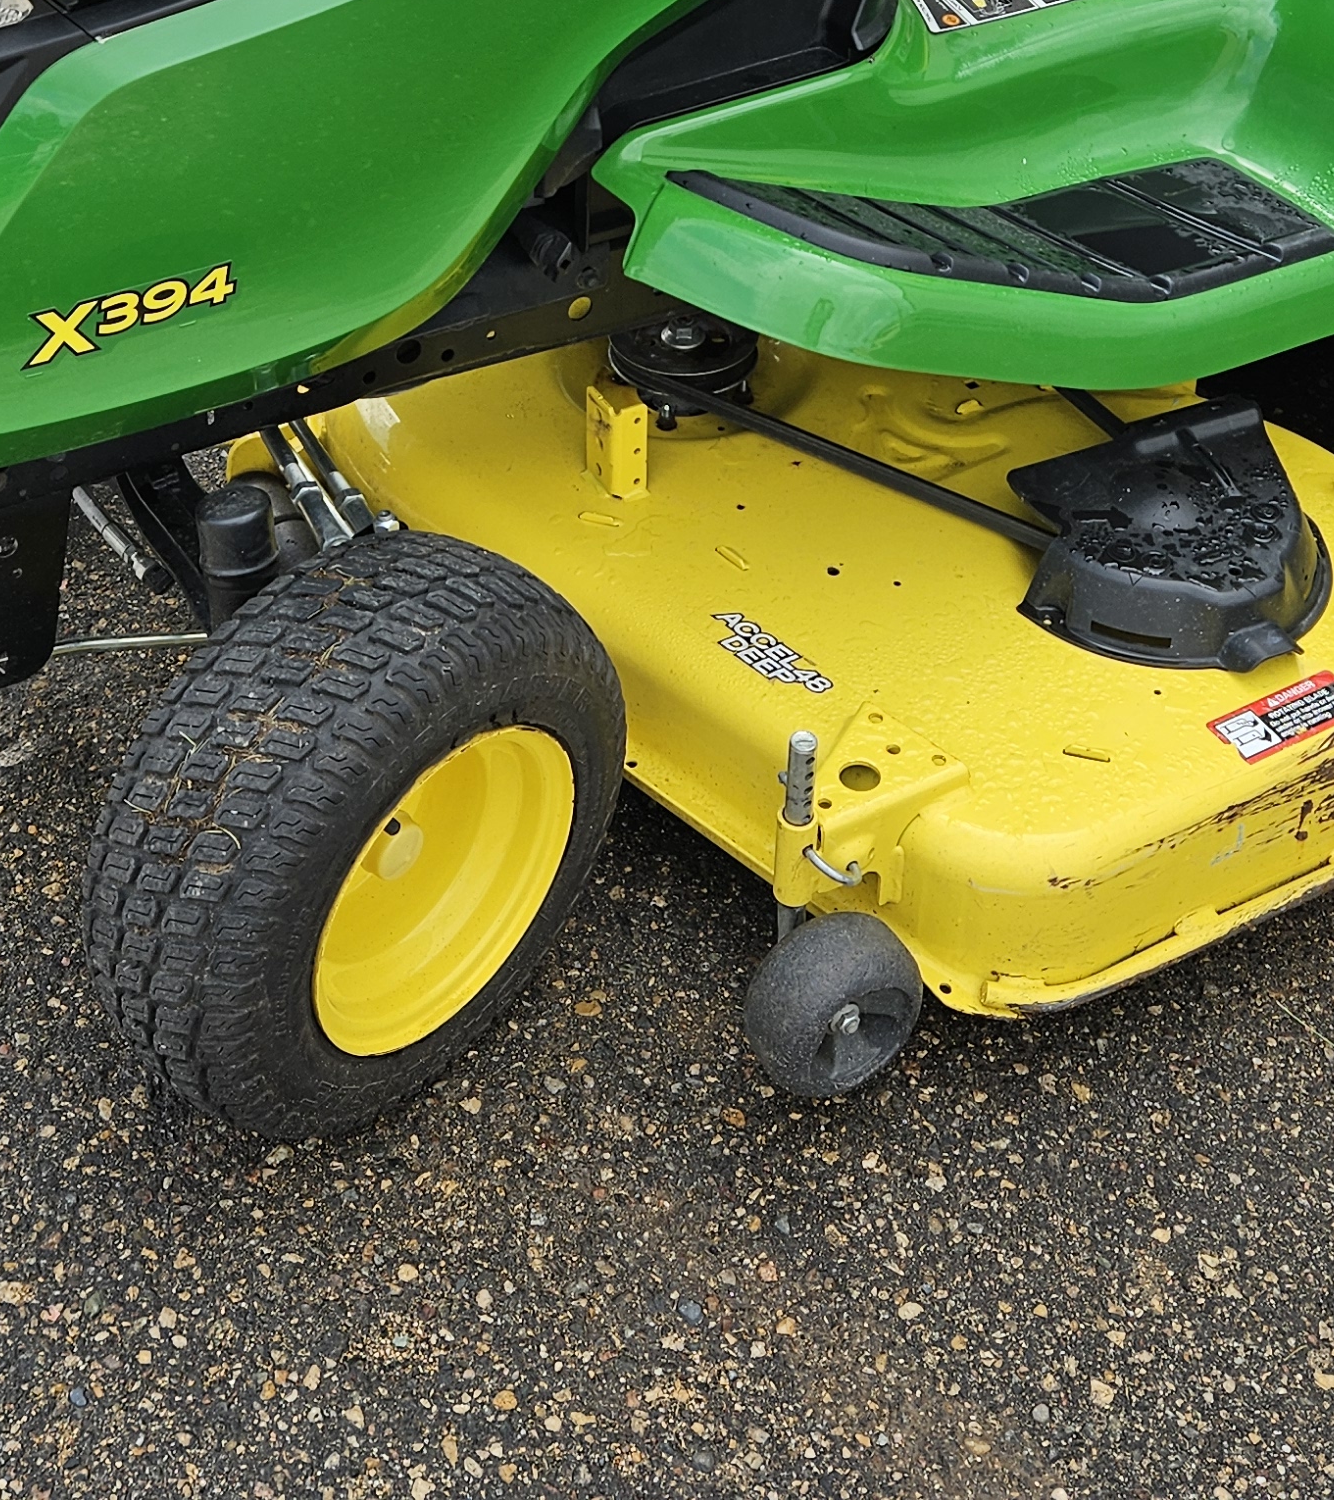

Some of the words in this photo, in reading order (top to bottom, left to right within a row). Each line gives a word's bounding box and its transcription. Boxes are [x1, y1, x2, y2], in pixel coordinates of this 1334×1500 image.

[22, 261, 237, 370] X394
[710, 613, 803, 671] ACCEL
[793, 670, 833, 693] 48
[718, 635, 797, 684] DEEP
[1268, 699, 1306, 719] ROTATING
[1303, 687, 1329, 704] BLADE
[1275, 680, 1316, 701] DANGER
